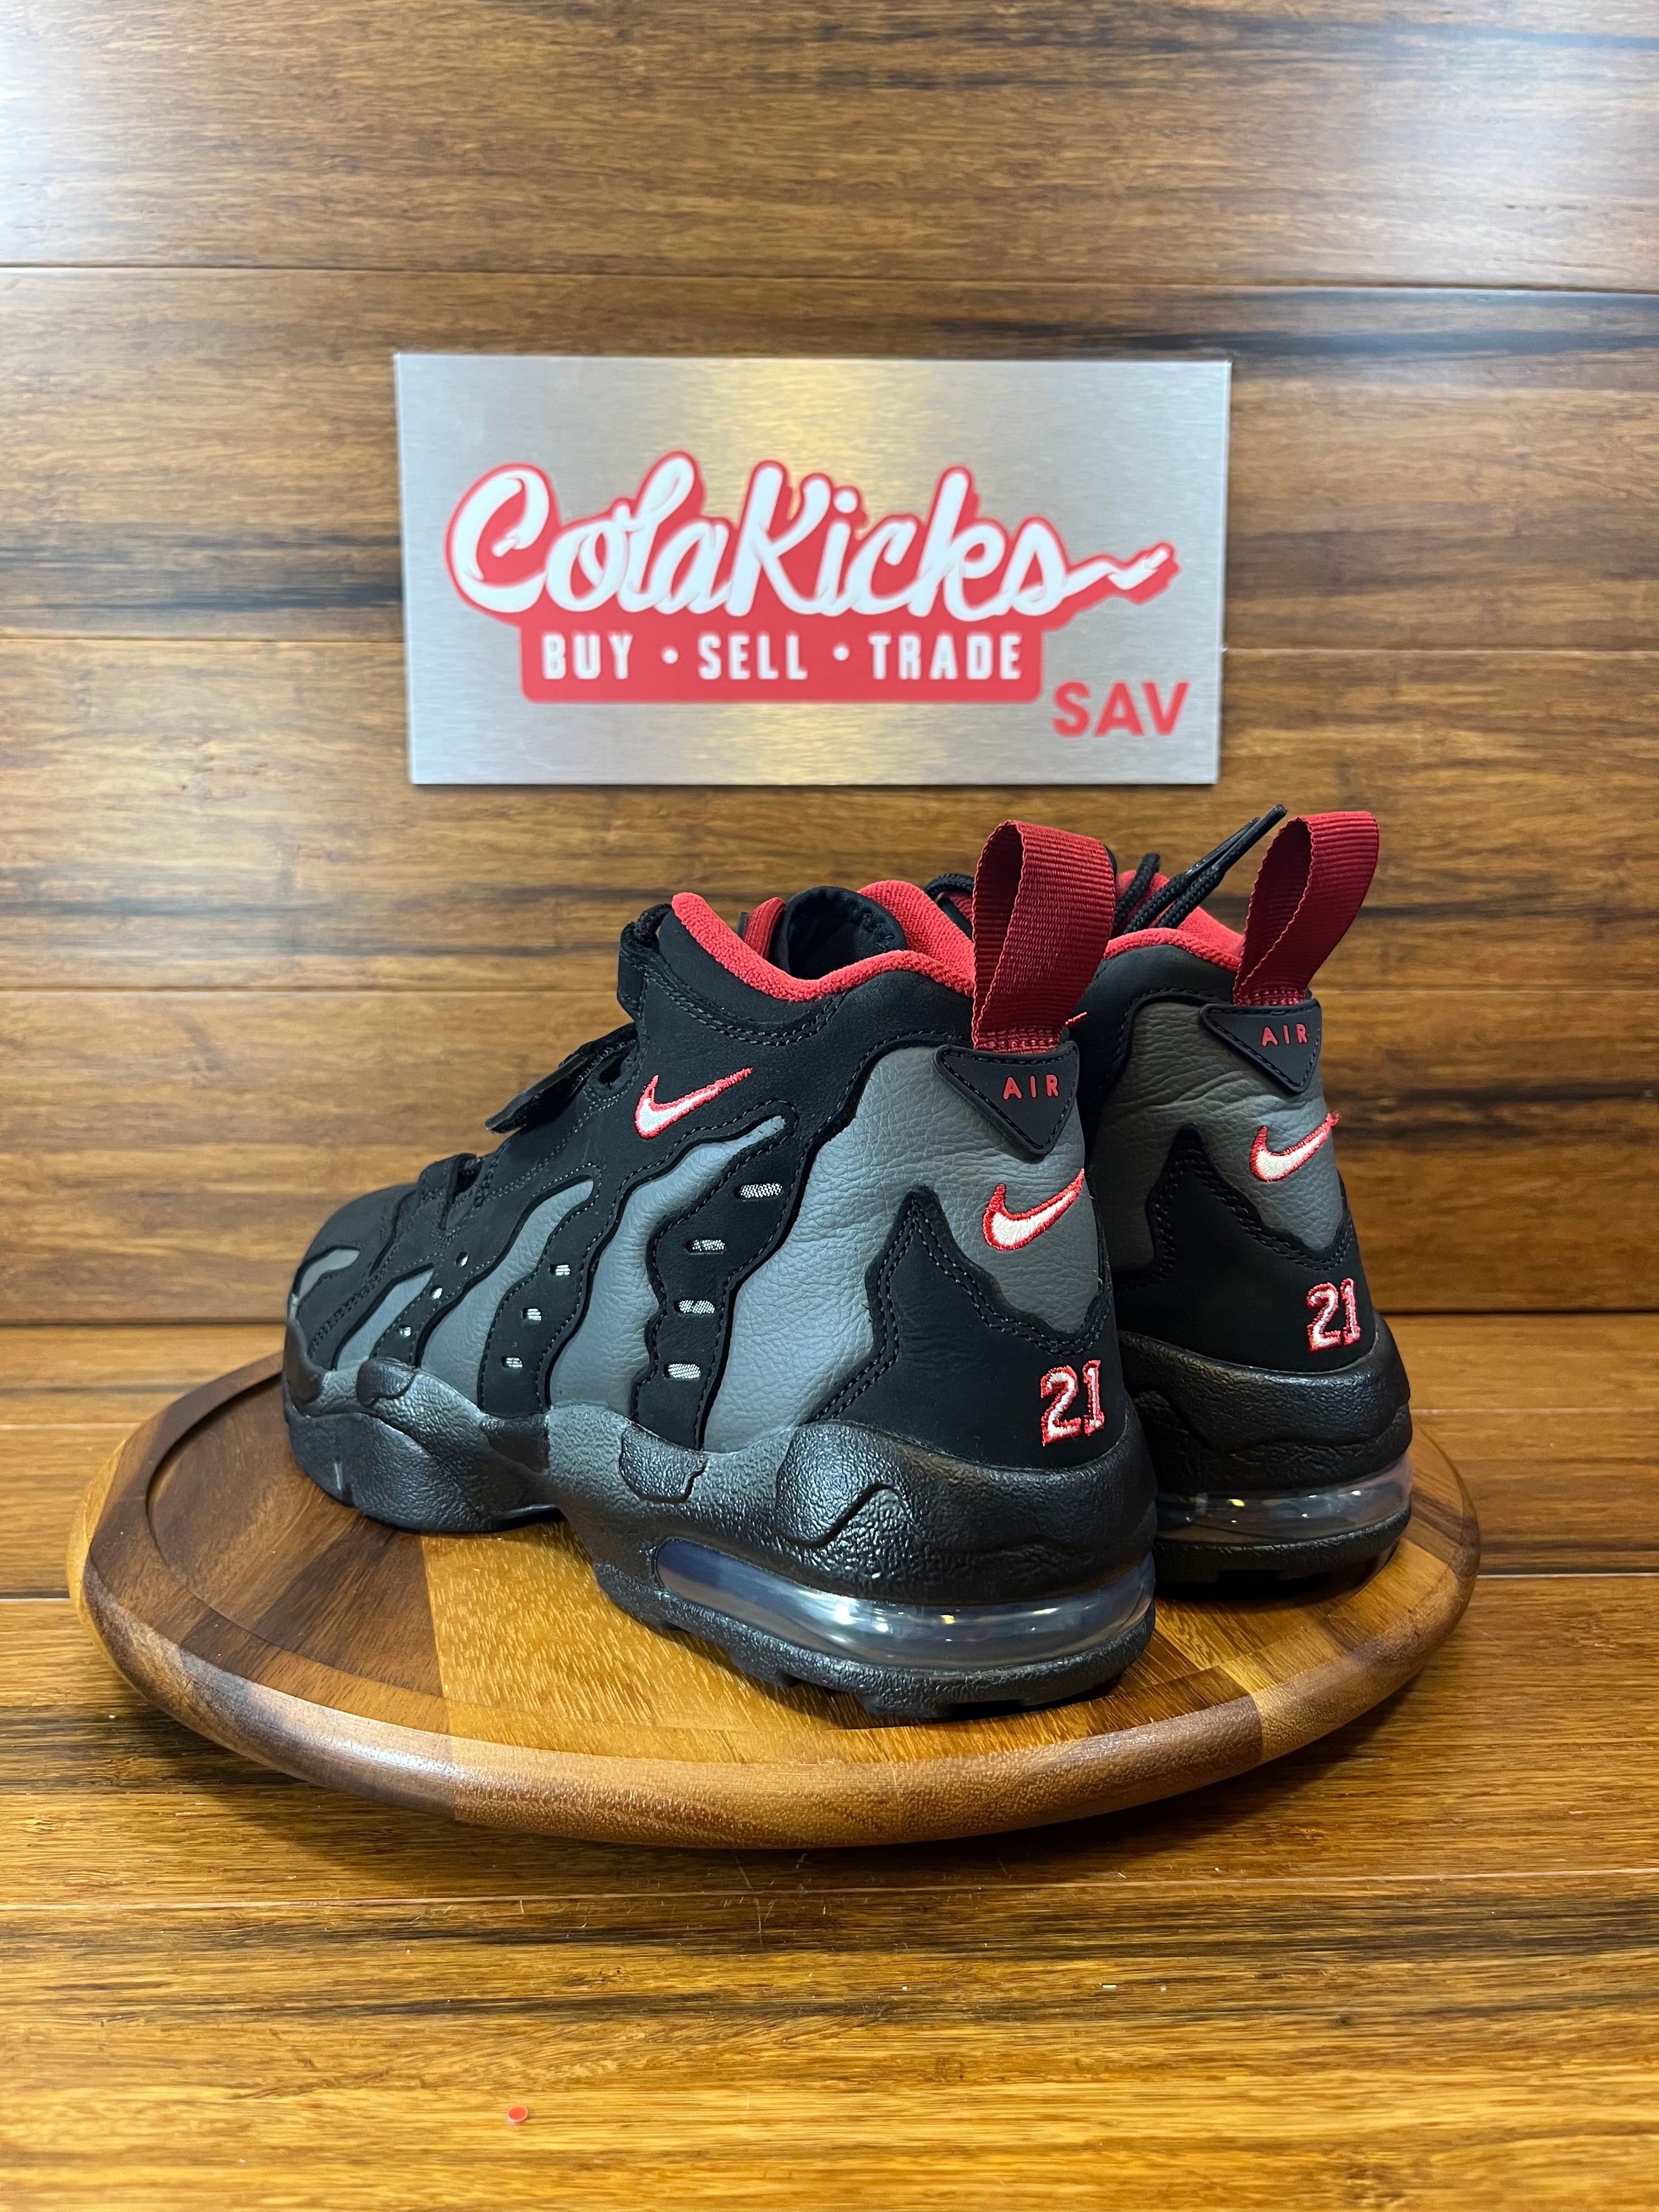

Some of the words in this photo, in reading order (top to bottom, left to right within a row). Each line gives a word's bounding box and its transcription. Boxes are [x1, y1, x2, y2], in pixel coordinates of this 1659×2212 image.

[452, 454, 1173, 622] ColaKicks
[541, 633, 634, 680] BUY
[697, 633, 809, 681] SELL
[868, 633, 1023, 681] TRADE
[1052, 681, 1189, 737] SAV
[1261, 1023, 1308, 1047] AIR
[1002, 1074, 1059, 1100] AIR
[1306, 1277, 1362, 1352] 21
[1040, 1359, 1105, 1447] 21
